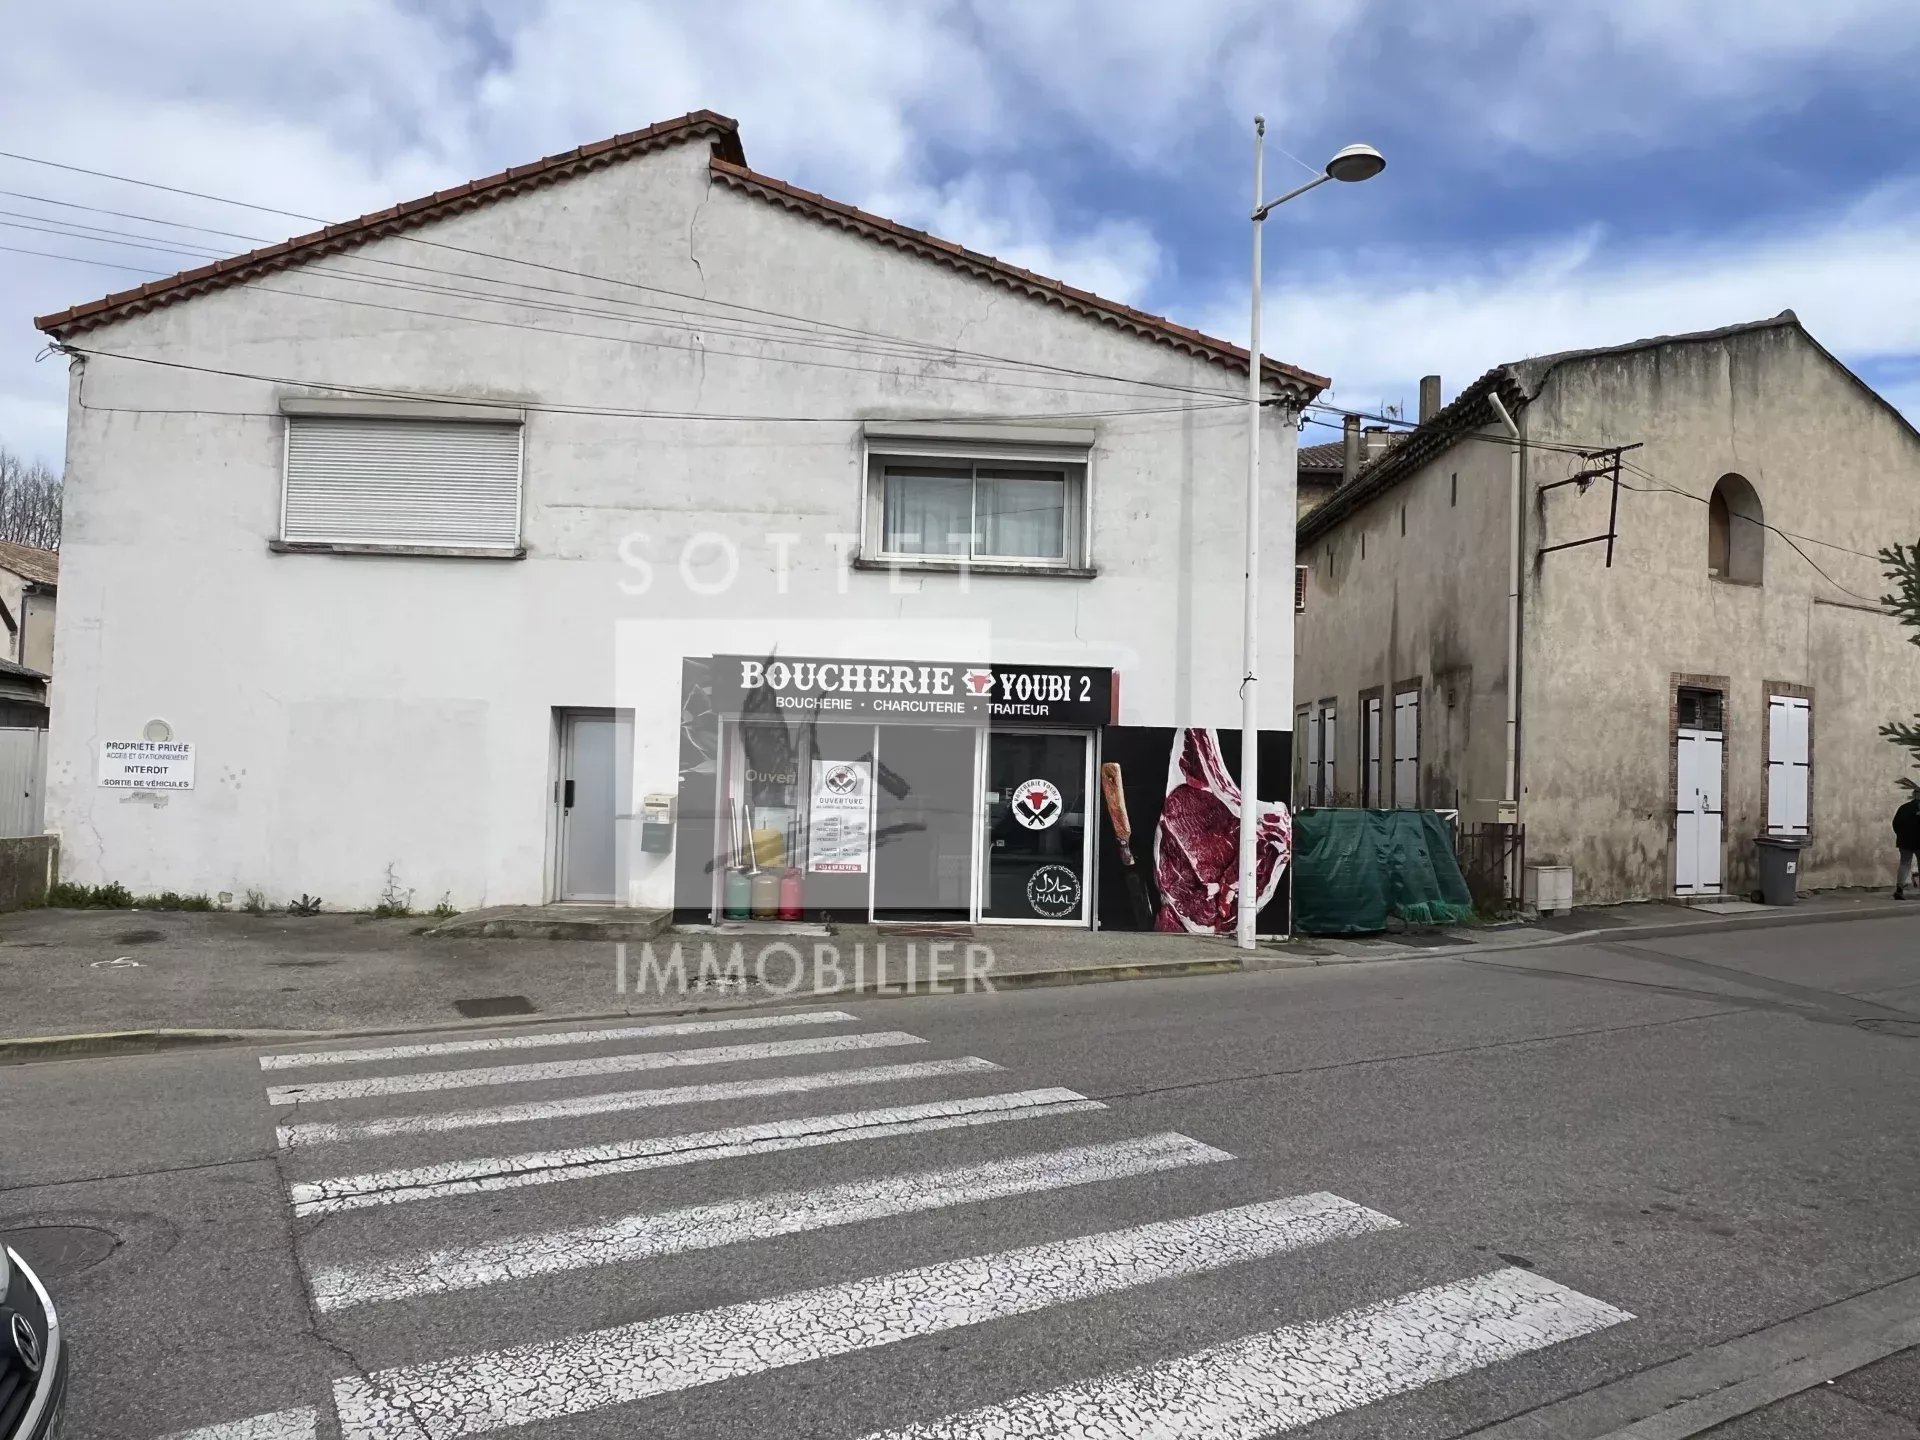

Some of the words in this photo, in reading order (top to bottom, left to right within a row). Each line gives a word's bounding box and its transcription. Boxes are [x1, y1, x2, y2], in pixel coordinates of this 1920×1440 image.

[741, 661, 954, 695] BOUCHERIE
[1000, 674, 1071, 701] YOUBI
[1079, 676, 1091, 701] 2
[775, 697, 852, 710] BOUCHERIE
[873, 700, 965, 714] CHARCUTERIE
[986, 703, 1049, 716] TRAITEUR
[124, 766, 169, 774] INTERDIT
[104, 779, 131, 787] SORTIE
[134, 779, 144, 787] DE
[819, 797, 864, 805] OUVERTURE
[1036, 873, 1072, 892] حلال
[1036, 893, 1073, 904] HALAL
